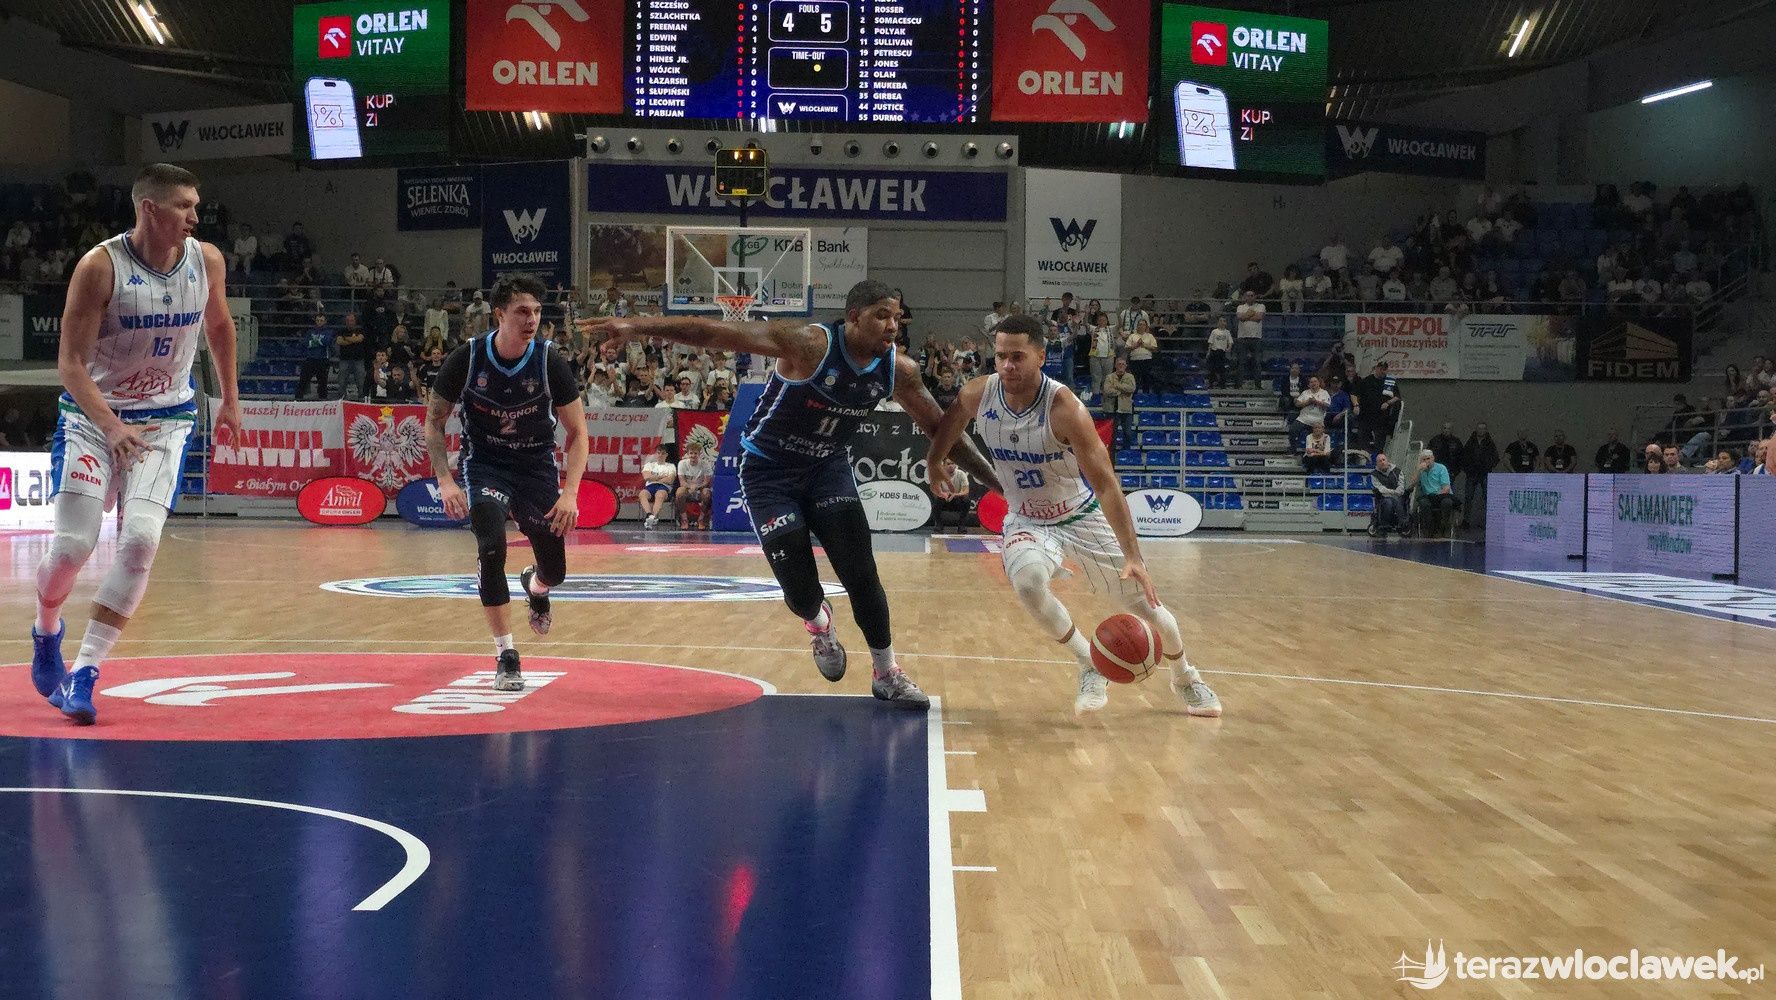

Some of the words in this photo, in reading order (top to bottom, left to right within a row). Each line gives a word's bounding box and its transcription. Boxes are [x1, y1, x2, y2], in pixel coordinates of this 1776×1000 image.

[752, 3, 758, 11] 0
[798, 4, 820, 14] FOULS
[874, 6, 904, 14] ROSSER
[356, 9, 428, 35] ORLEN
[649, 12, 701, 20] SZLACHETKA
[751, 14, 758, 22] 0
[782, 12, 795, 32] 4
[820, 14, 832, 33] 5
[874, 17, 922, 25] SOMACESCU
[636, 22, 642, 30] 5
[649, 23, 688, 31] FREEMAN
[751, 25, 758, 33] 4
[972, 29, 979, 37] 0
[636, 33, 642, 41] 6
[649, 34, 677, 42] EDWIN
[860, 38, 868, 46] 11
[873, 38, 913, 46] SULLIVAN
[1232, 27, 1306, 54] ORLEN
[357, 37, 405, 56] VITAY
[635, 44, 642, 52] 7
[649, 44, 677, 52] BRENK
[791, 51, 825, 61] TIME-OUT
[860, 49, 869, 57] 19
[873, 49, 913, 57] PETRESCU
[649, 55, 674, 63] HINES
[751, 57, 757, 65] 7
[873, 60, 899, 68] JONES
[972, 61, 978, 69] 0
[1232, 52, 1284, 72] VITAY
[492, 60, 599, 86] ORLEN
[649, 65, 681, 74] WÓJCIK
[751, 68, 757, 76] 0
[873, 71, 896, 79] OLAH
[971, 72, 978, 80] 0
[648, 77, 688, 85] ŁAZARSKI
[750, 79, 757, 87] 0
[873, 82, 908, 90] MUKEBA
[971, 83, 977, 91] 0
[1017, 70, 1124, 96] ORLEN
[635, 87, 645, 95] 16
[858, 92, 869, 100] 35
[872, 92, 903, 100] GIRBEA
[635, 98, 646, 106] 20
[648, 98, 686, 107] LECOMTE
[872, 103, 905, 111] JUSTICE
[971, 105, 977, 113] 2
[635, 109, 645, 117] 21
[750, 111, 756, 119] 0
[799, 105, 839, 113] WŁOCŁAWEK
[872, 114, 904, 122] DURMO
[199, 121, 284, 142] WŁOCŁAWEK
[1387, 138, 1476, 160] WŁOCŁAWEK
[407, 184, 470, 208] SELENKA
[665, 173, 926, 213] WŁCŁAWEK
[817, 240, 850, 253] Bank
[492, 251, 558, 264] WŁOCŁAWEK
[1038, 260, 1108, 273] WŁOCŁAWEK
[1356, 316, 1448, 336] DUSZPOL
[152, 337, 173, 357] 16
[1356, 338, 1388, 348] Kamil
[1391, 338, 1448, 350] Duszyński
[1587, 360, 1679, 378] FIDEM
[243, 405, 279, 418] naszej
[283, 405, 337, 416] hierarchii
[490, 405, 538, 419] MAGNOR
[814, 416, 840, 437] 11
[214, 428, 331, 468] ANWIL
[70, 471, 101, 486] ORLEN
[1014, 469, 1045, 489] 20
[320, 487, 363, 507] Anwil
[417, 506, 444, 514] WŁOCŁ
[1618, 493, 1694, 526] SALAMANDER
[760, 513, 788, 537] SIXT
